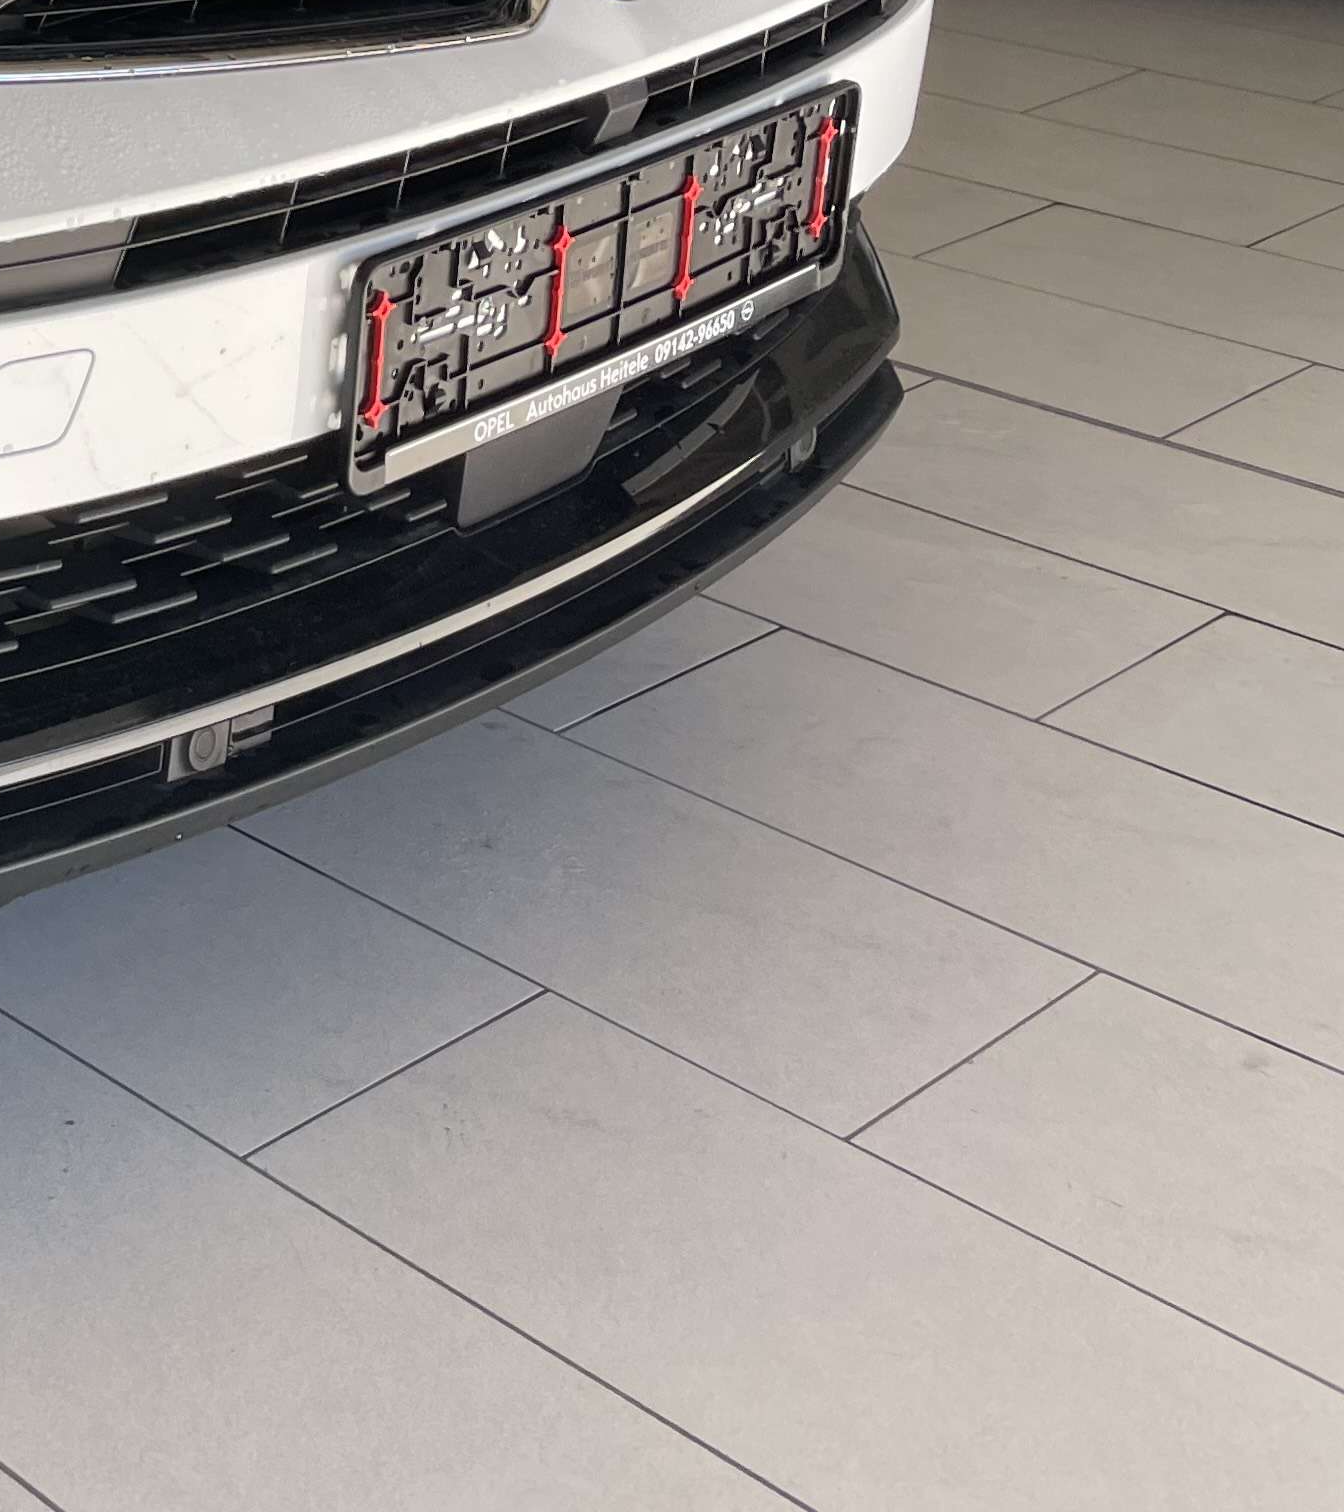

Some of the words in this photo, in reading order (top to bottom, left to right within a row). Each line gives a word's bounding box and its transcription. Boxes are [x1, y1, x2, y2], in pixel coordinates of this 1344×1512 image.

[474, 410, 514, 442] OPEL
[526, 381, 597, 420] Autohaus
[600, 353, 649, 389] Heitele
[654, 310, 735, 364] 09142-96650
